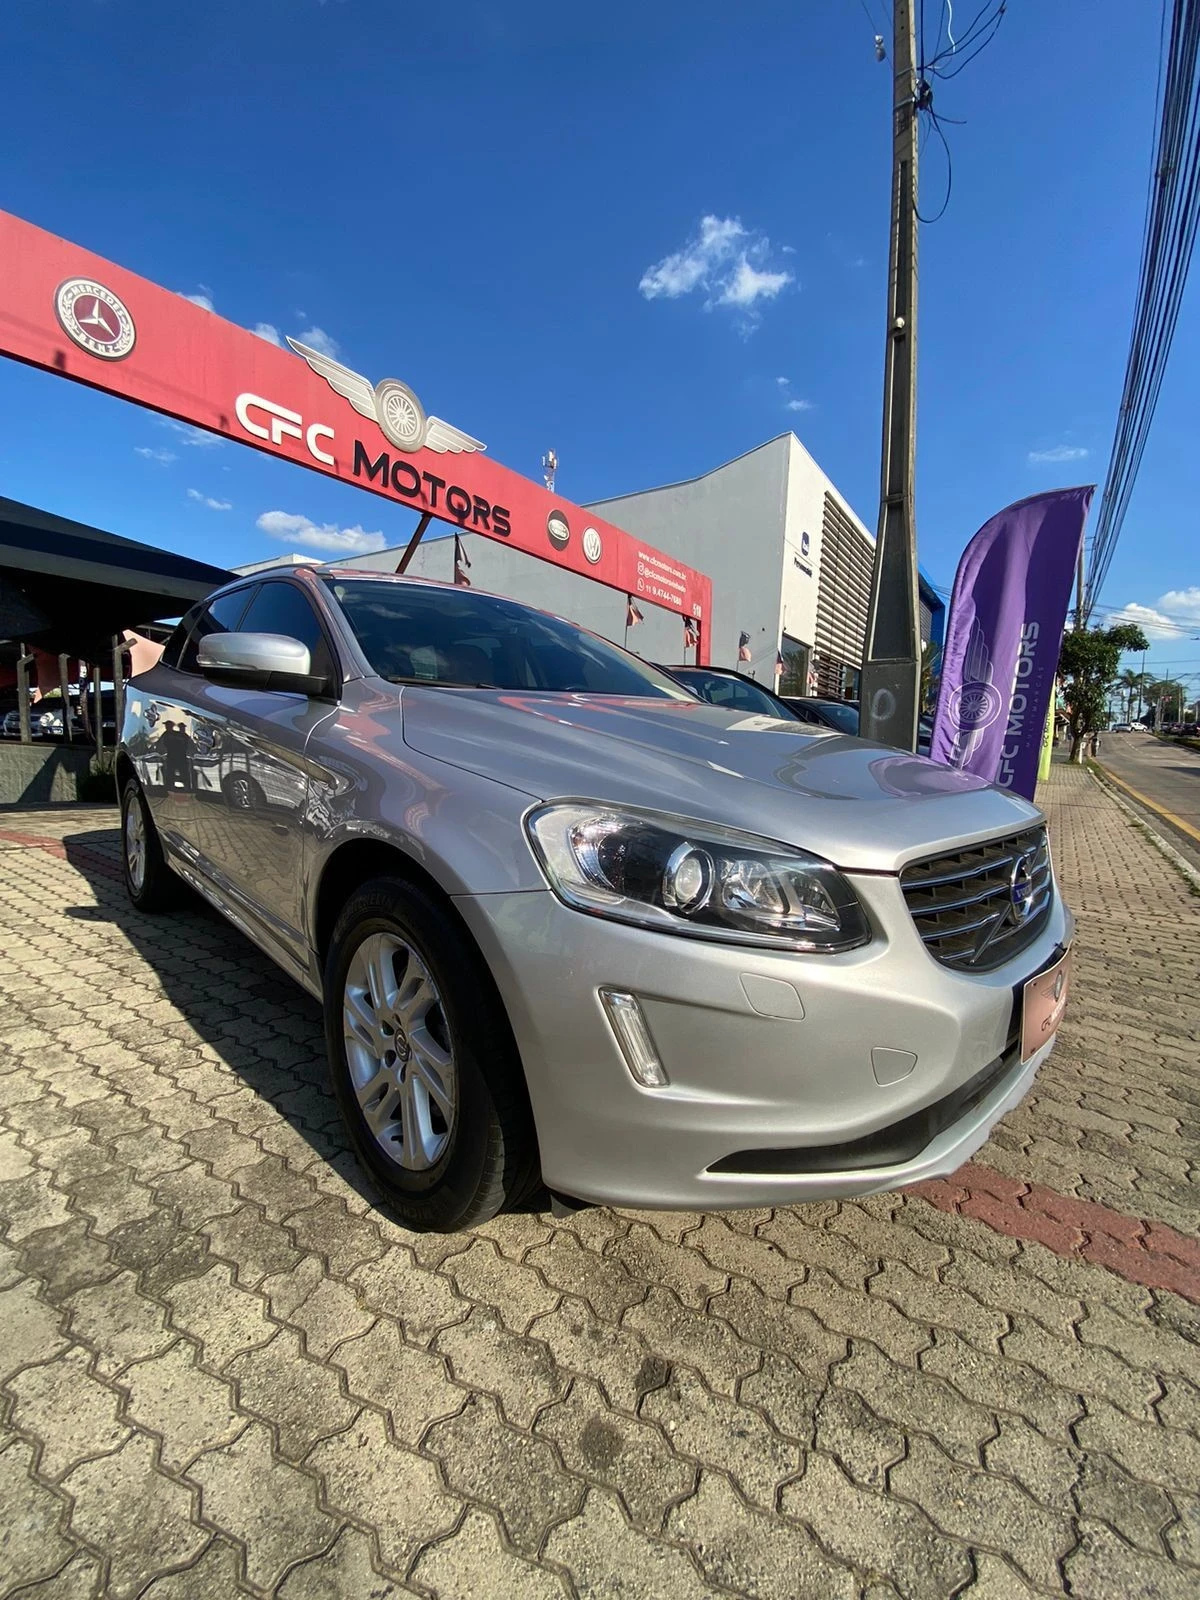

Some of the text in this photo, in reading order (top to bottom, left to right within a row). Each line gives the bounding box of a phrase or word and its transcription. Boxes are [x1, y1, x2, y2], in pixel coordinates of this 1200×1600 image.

[70, 284, 125, 316] MERCEDES
[78, 332, 115, 353] BENZ
[235, 392, 511, 537] CFC MOTORS
[995, 621, 1040, 788] CFC MOTORS
